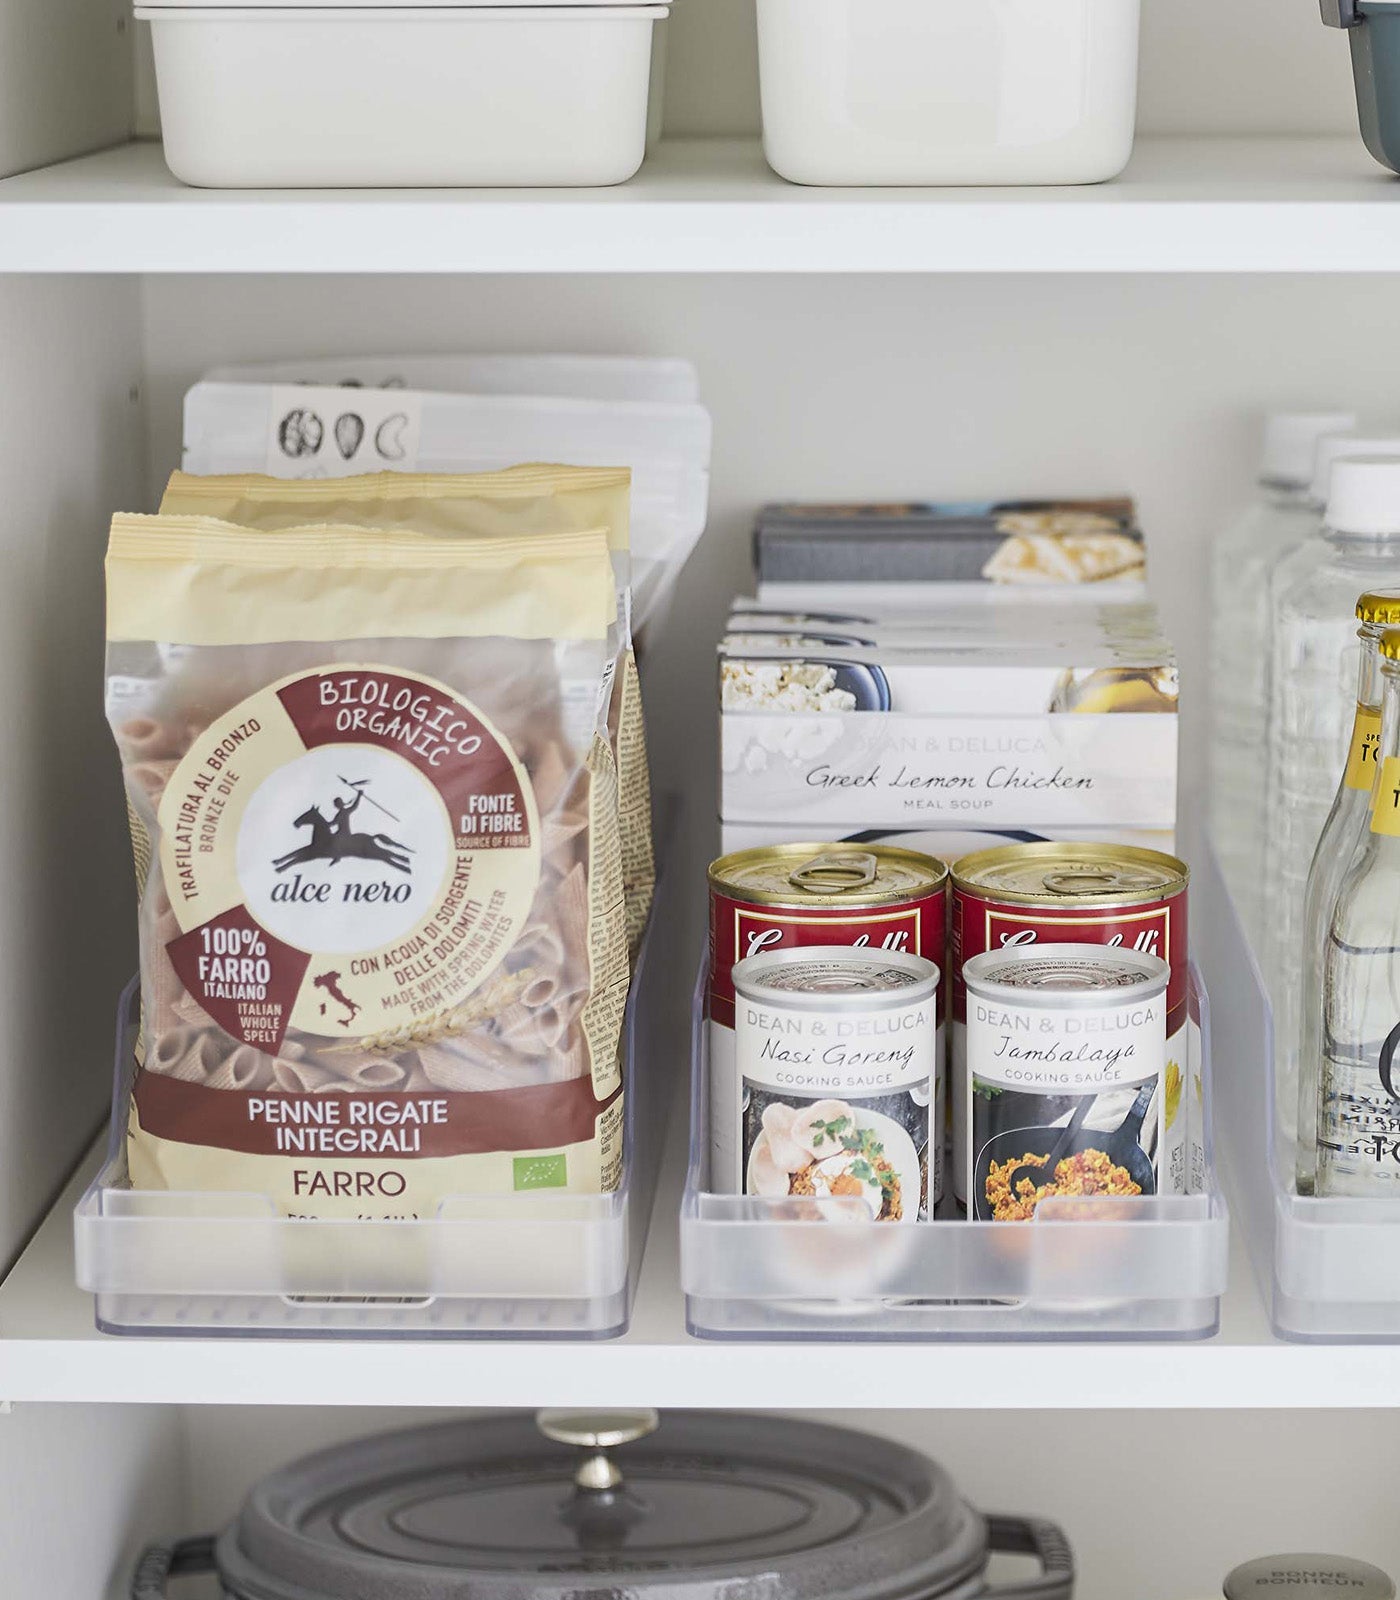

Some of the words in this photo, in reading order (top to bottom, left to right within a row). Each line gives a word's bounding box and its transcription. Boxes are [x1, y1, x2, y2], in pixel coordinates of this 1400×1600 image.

[319, 679, 482, 756] BIOLOGICO
[336, 708, 451, 767] ORGANIC
[949, 734, 1047, 754] DELUCA
[806, 765, 881, 788] Greek
[888, 765, 977, 789] Lemon
[986, 766, 1095, 789] Chicken
[175, 793, 204, 901] TRAFILATURA
[194, 772, 216, 793] AL
[206, 718, 262, 772] BRONZO
[199, 797, 227, 853] BRONZE
[217, 770, 241, 796] DIE
[469, 793, 516, 814] FONTE
[903, 800, 944, 810] MEAL
[950, 800, 994, 810] SOUP
[461, 814, 477, 834] DI
[480, 813, 522, 833] FIBRE
[270, 874, 332, 903] alce
[343, 880, 412, 904] nero
[350, 958, 380, 976] CON
[383, 935, 429, 970] ACQUA
[423, 918, 442, 940] DI
[435, 854, 474, 926] SORGENTE
[199, 927, 267, 957] 100%
[393, 953, 437, 986] DELLE
[433, 899, 484, 961] DOLOMITI
[198, 956, 271, 984] FARRO
[381, 985, 415, 1010] MADE
[447, 930, 486, 975] SPRING
[204, 982, 267, 1001] ITALIANO
[238, 1003, 282, 1016] ITALIAN
[746, 1009, 801, 1034] DEAN
[811, 1021, 828, 1036] &
[976, 1005, 1031, 1032] DEAN
[1039, 1018, 1055, 1034] &
[240, 1017, 280, 1030] WHOLE
[243, 1030, 278, 1042] SPELT
[760, 1038, 816, 1064] Nasi
[822, 1044, 916, 1070] Goreng
[993, 1035, 1137, 1072] Jambalaya
[776, 1072, 841, 1086] COOKING
[847, 1073, 893, 1086] SAUCE
[1004, 1069, 1070, 1083] COOKING
[1074, 1070, 1122, 1083] SAUCE
[248, 1098, 341, 1125] PENNE
[349, 1100, 449, 1125] RIGATE
[276, 1127, 420, 1152] INTEGRALI
[293, 1170, 406, 1197] FARRO
[1255, 1578, 1366, 1588] BONHEUR
[1271, 1571, 1349, 1579] BONNE
